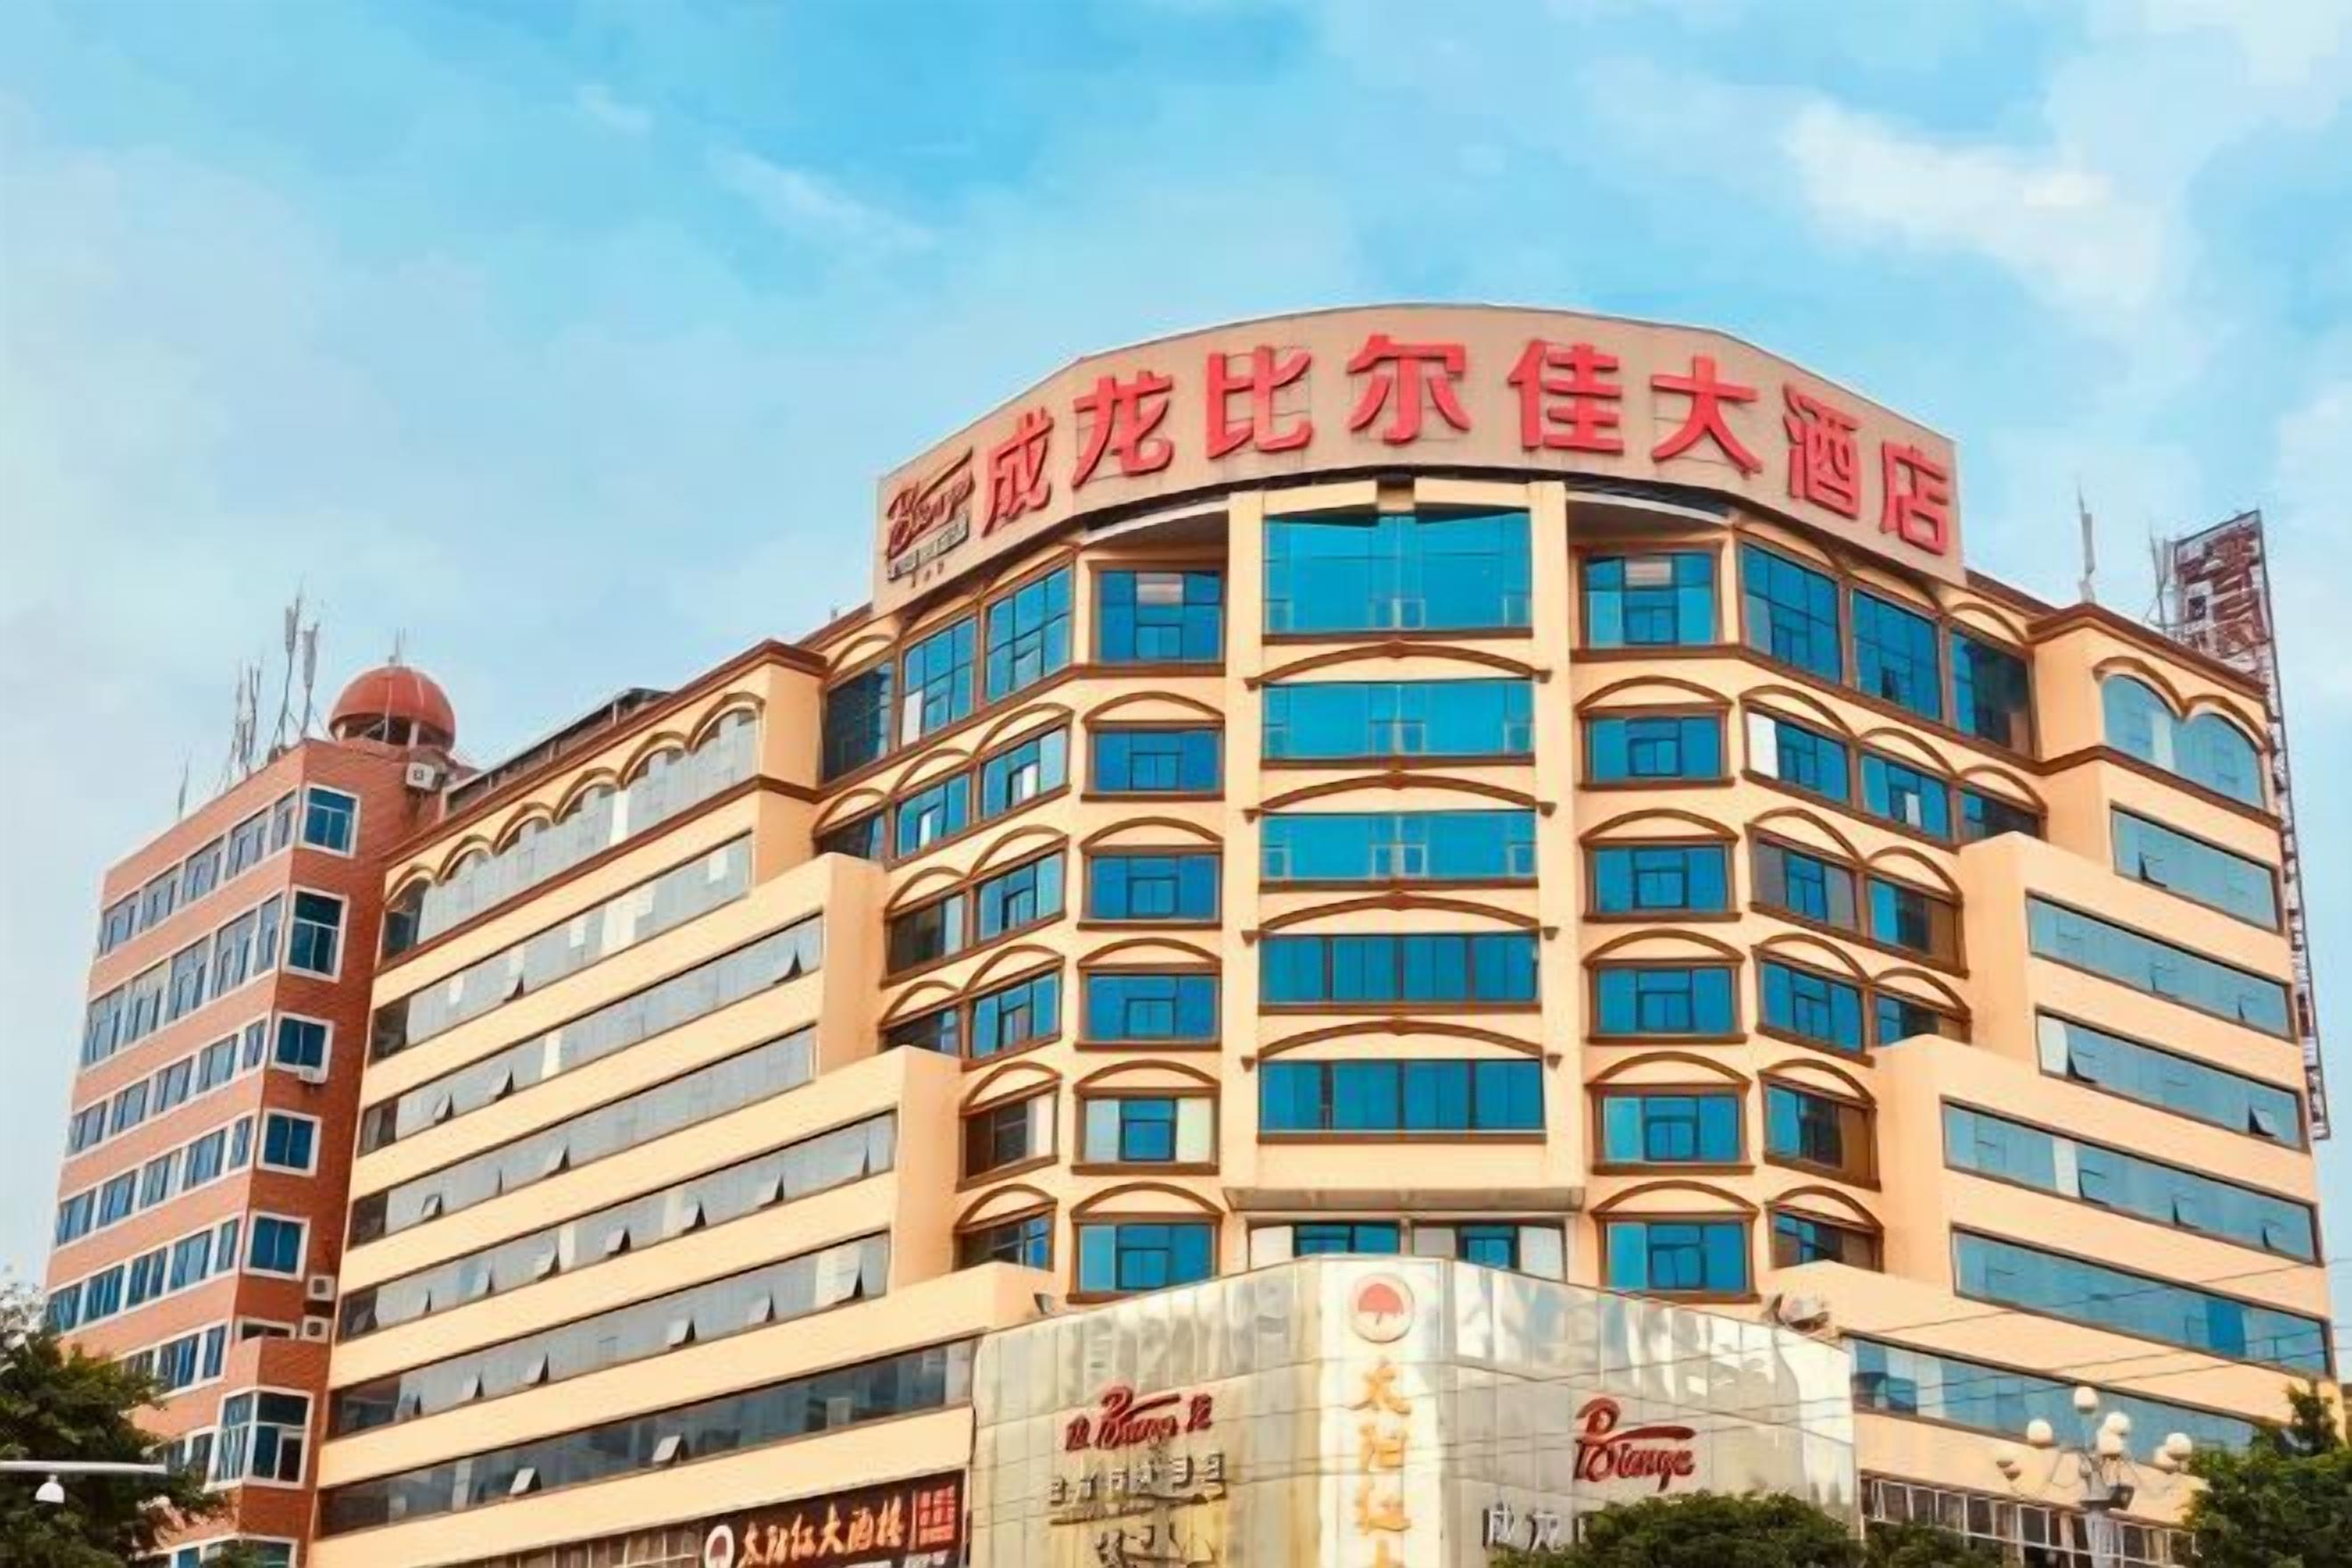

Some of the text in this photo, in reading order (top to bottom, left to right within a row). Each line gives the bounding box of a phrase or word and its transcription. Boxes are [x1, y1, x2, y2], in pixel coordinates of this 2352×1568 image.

[981, 331, 1951, 557] 成龙比尔佳大酒店
